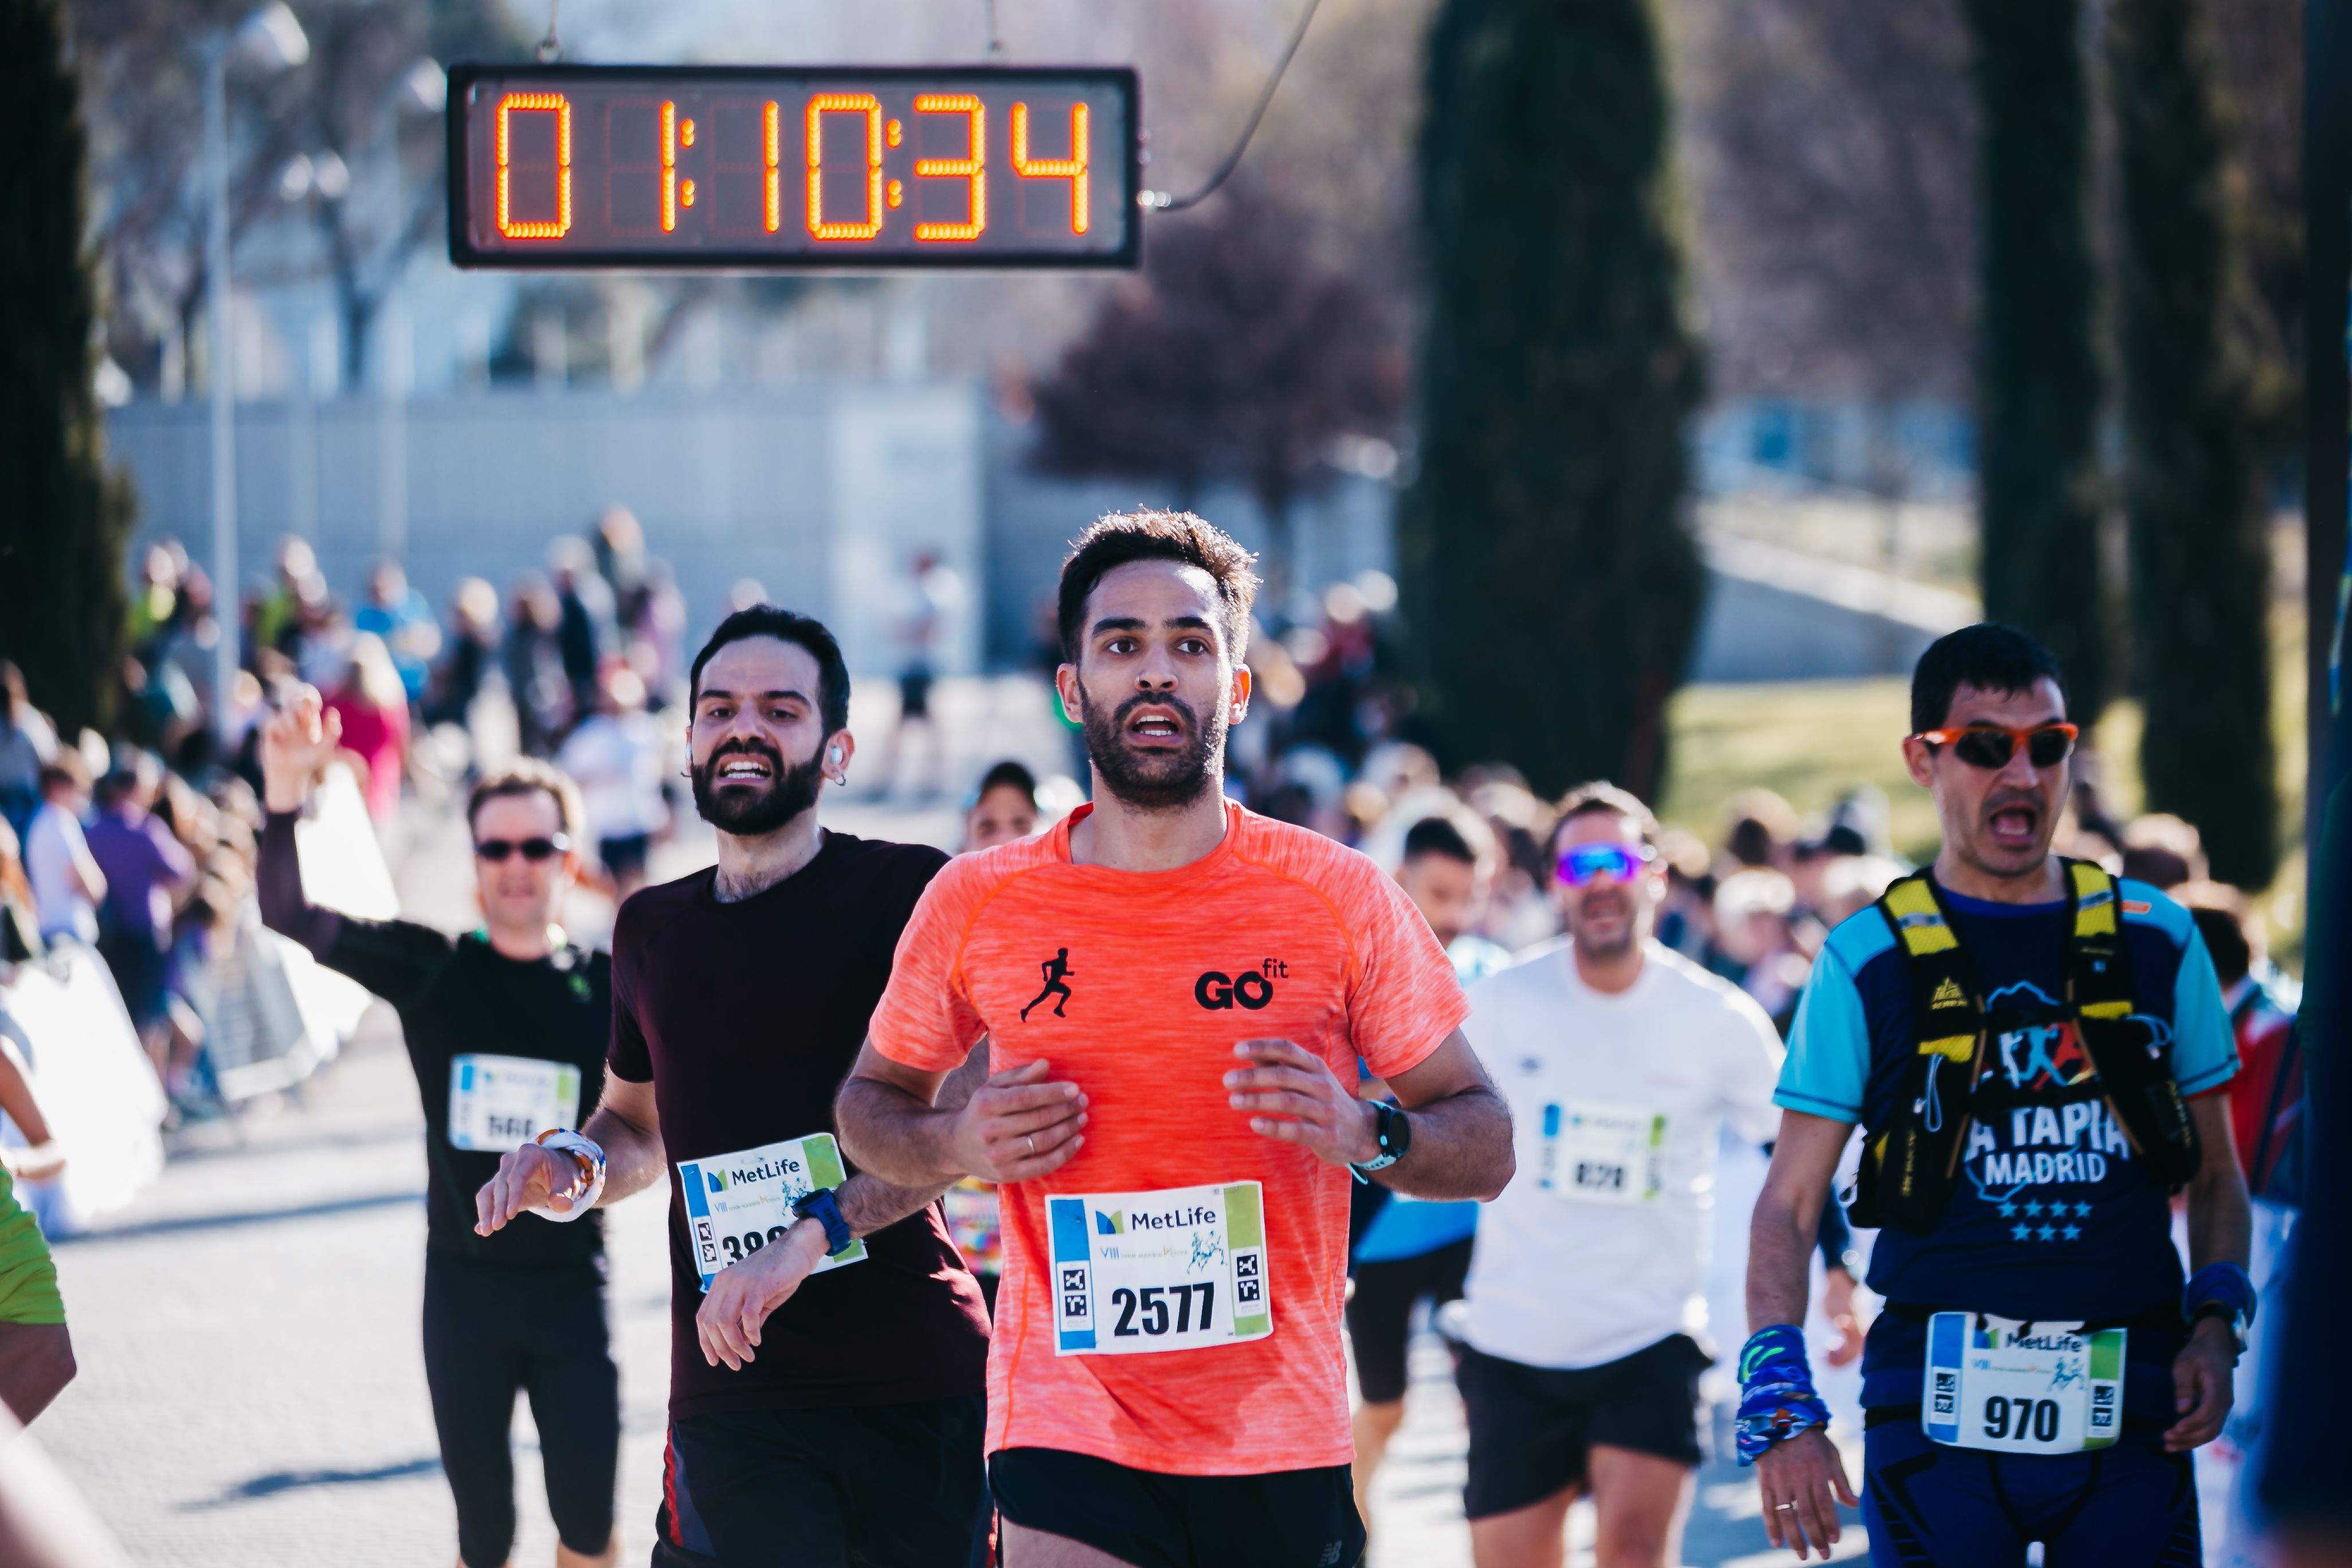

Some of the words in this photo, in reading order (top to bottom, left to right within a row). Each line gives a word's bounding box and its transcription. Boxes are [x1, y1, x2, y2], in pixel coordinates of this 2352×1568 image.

[495, 92, 1089, 241] 01:10:34
[732, 1158, 801, 1186] MetLife
[1985, 1150, 2107, 1185] MADRID
[1132, 1206, 1216, 1231] MetLife
[1100, 1246, 1119, 1260] VIII
[1111, 1280, 1215, 1338] 2577
[1983, 1395, 2060, 1442] 970
